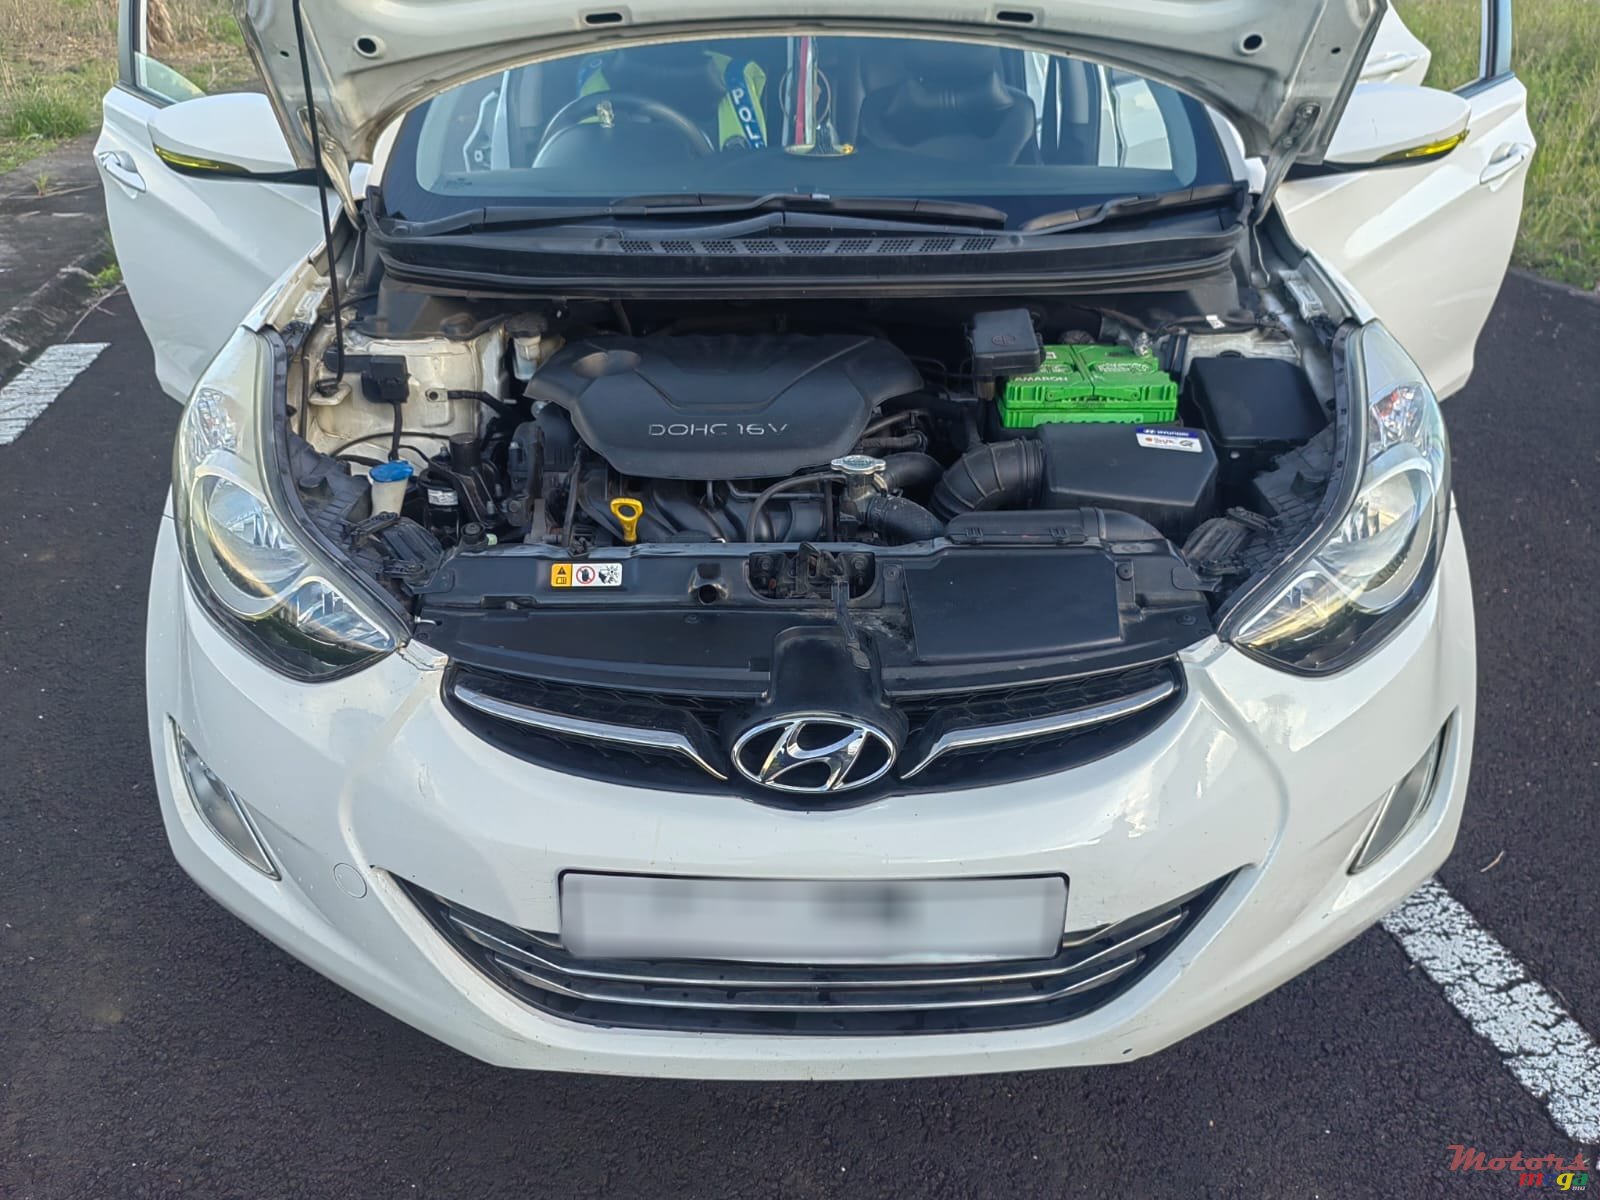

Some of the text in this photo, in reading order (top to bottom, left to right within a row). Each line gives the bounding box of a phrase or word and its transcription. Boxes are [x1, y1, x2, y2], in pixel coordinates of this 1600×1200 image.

[731, 88, 762, 149] POL
[648, 423, 788, 436] DOHC 16V
